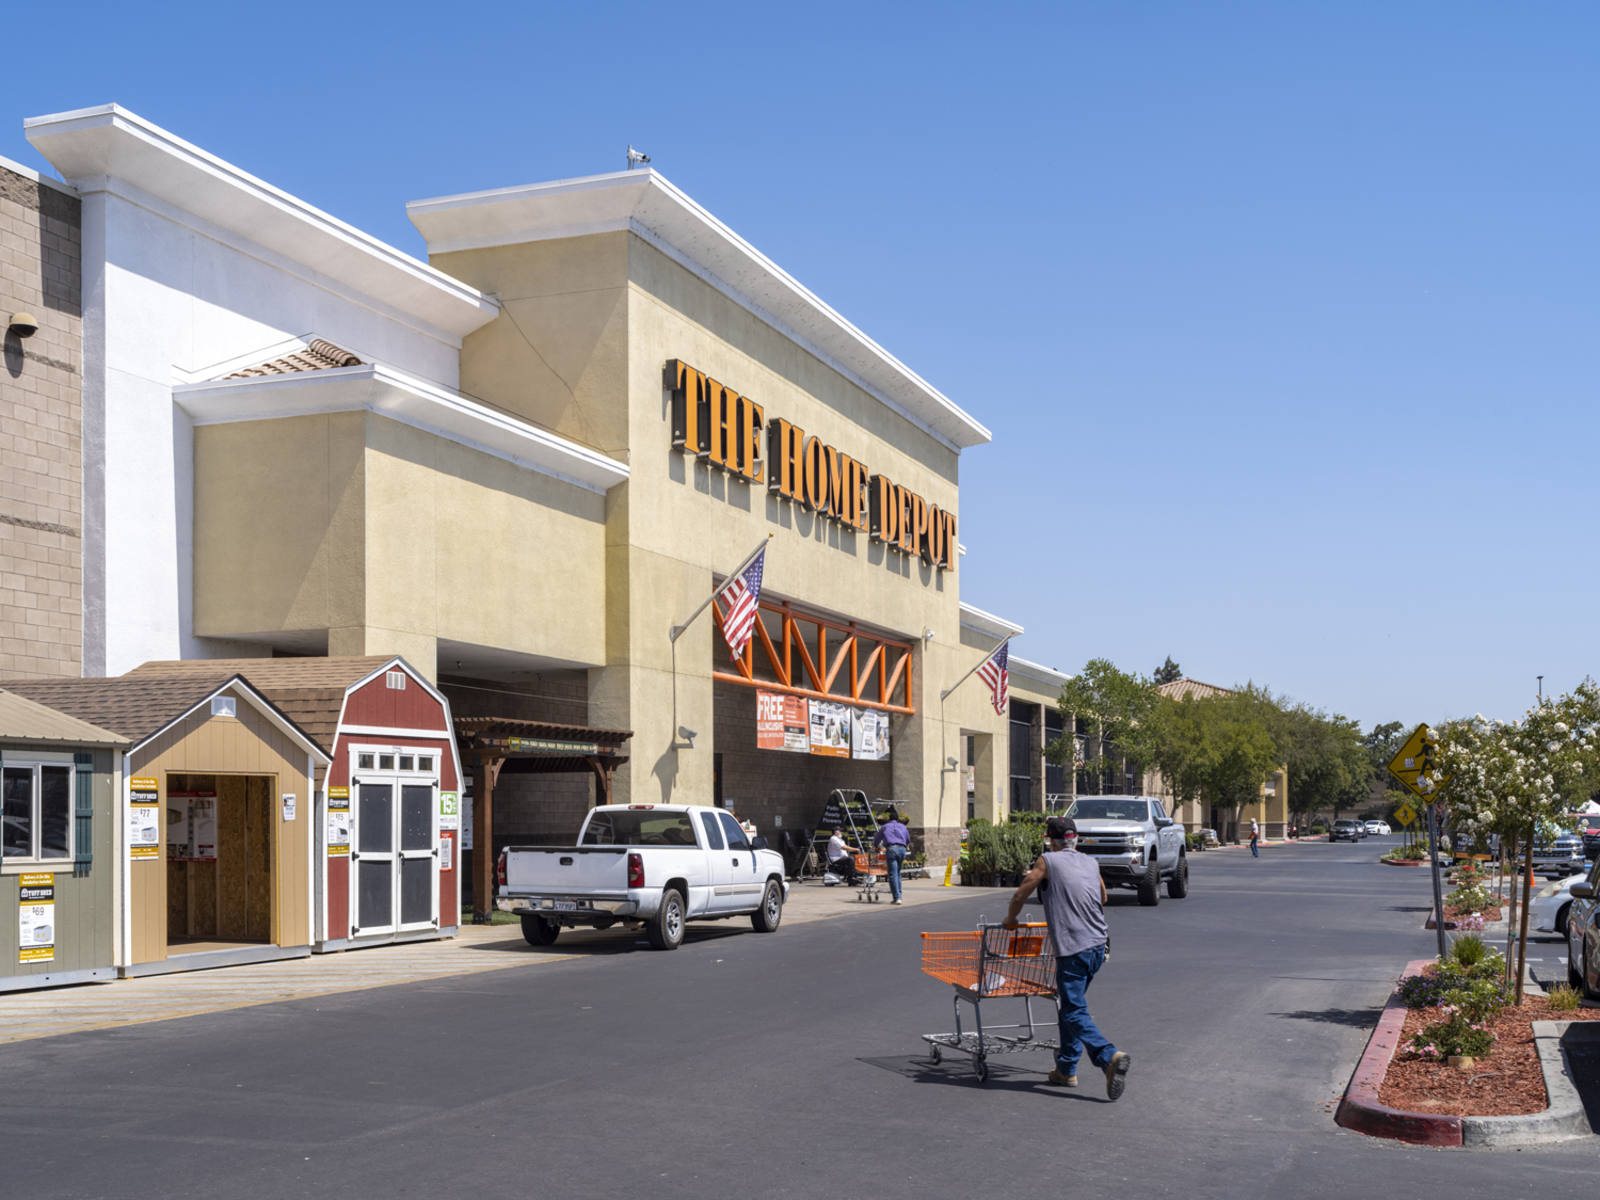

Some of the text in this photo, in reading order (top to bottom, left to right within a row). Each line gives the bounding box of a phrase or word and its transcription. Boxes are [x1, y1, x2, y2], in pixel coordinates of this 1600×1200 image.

[668, 360, 957, 572] THE HOME DEPOT
[757, 695, 784, 720] FREE
